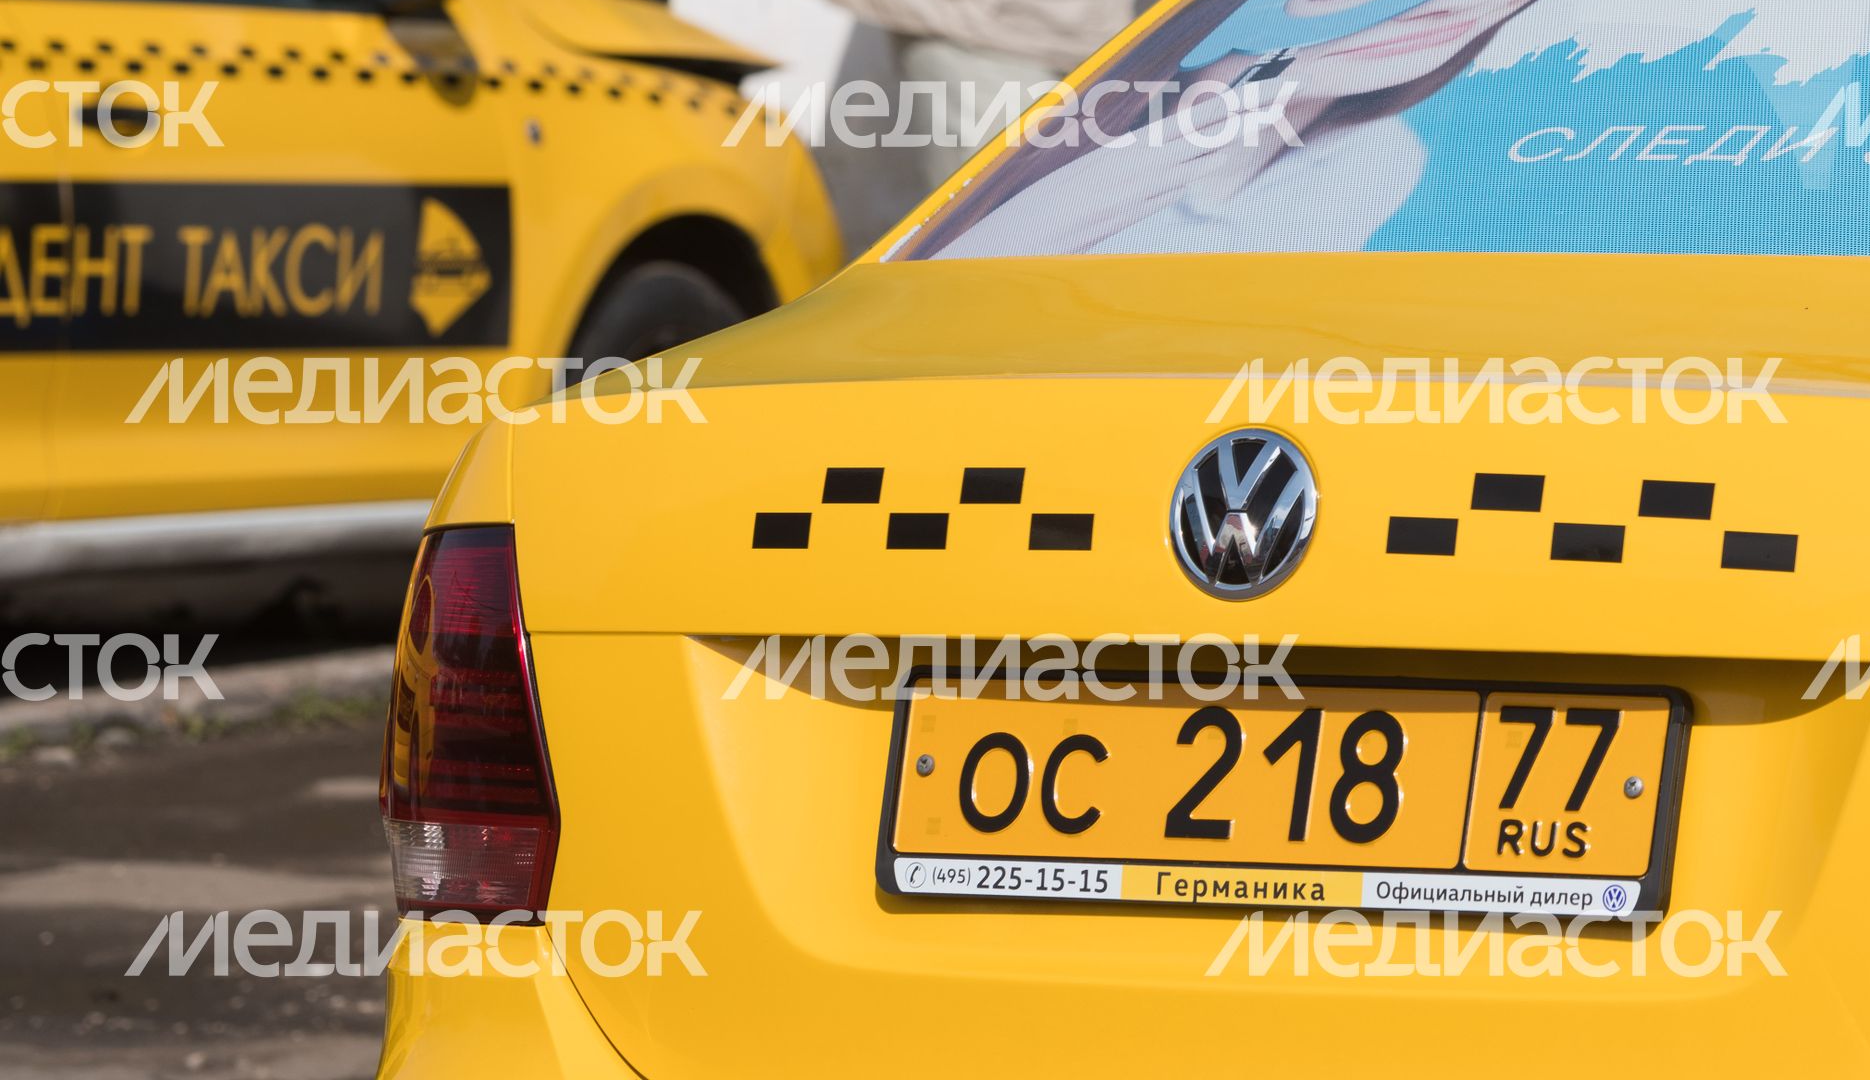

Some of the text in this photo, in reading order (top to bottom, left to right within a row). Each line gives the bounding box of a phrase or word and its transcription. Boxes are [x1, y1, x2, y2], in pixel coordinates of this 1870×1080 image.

[1506, 124, 1842, 168] СЛЕДИ
[177, 223, 385, 319] ТАКСИ
[1164, 706, 1406, 845] 218
[1497, 706, 1622, 812] 77
[1497, 819, 1590, 858] RUS
[932, 865, 1109, 894] (495) 225-15-15
[1155, 871, 1326, 904] Германика
[1376, 880, 1593, 909] Официальный дилер
